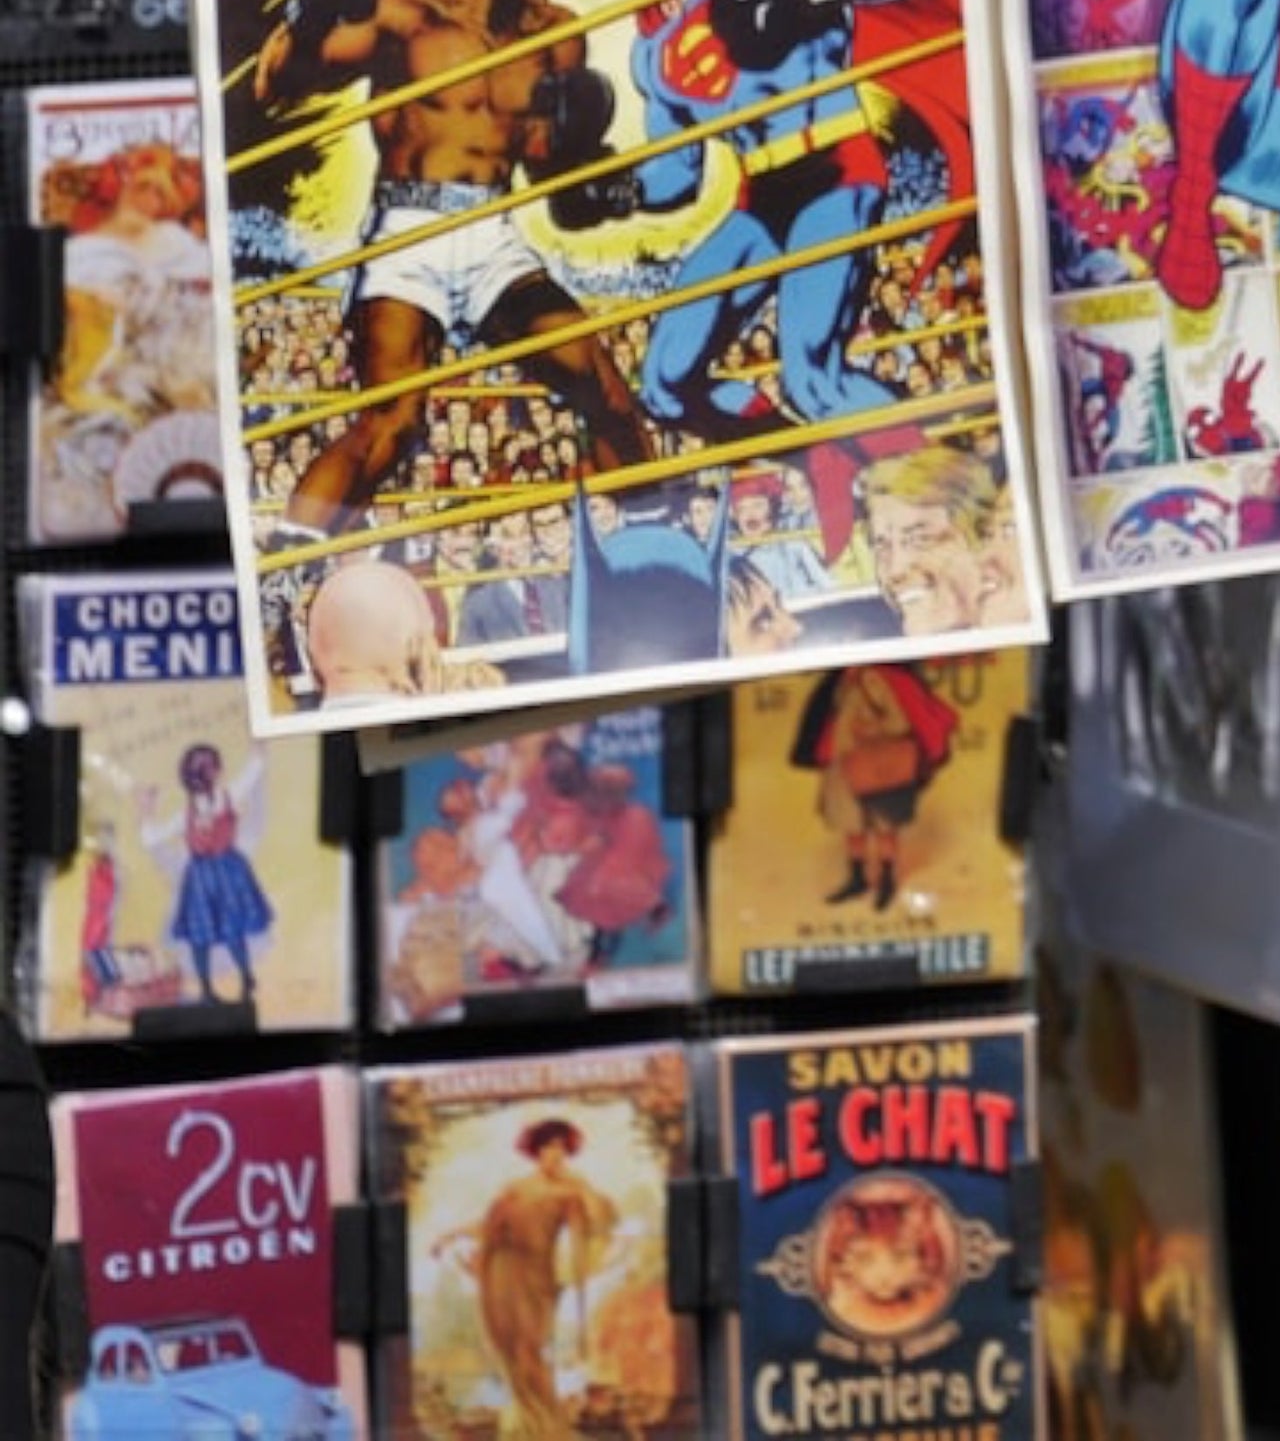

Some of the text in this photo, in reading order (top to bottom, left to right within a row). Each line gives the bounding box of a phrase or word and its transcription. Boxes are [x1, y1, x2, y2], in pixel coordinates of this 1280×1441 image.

[77, 591, 234, 632] CHOCO
[67, 629, 234, 683] MENI
[788, 1039, 972, 1092] SAVON
[750, 1082, 1017, 1197] LE CHAT
[166, 1109, 318, 1240] 2CV
